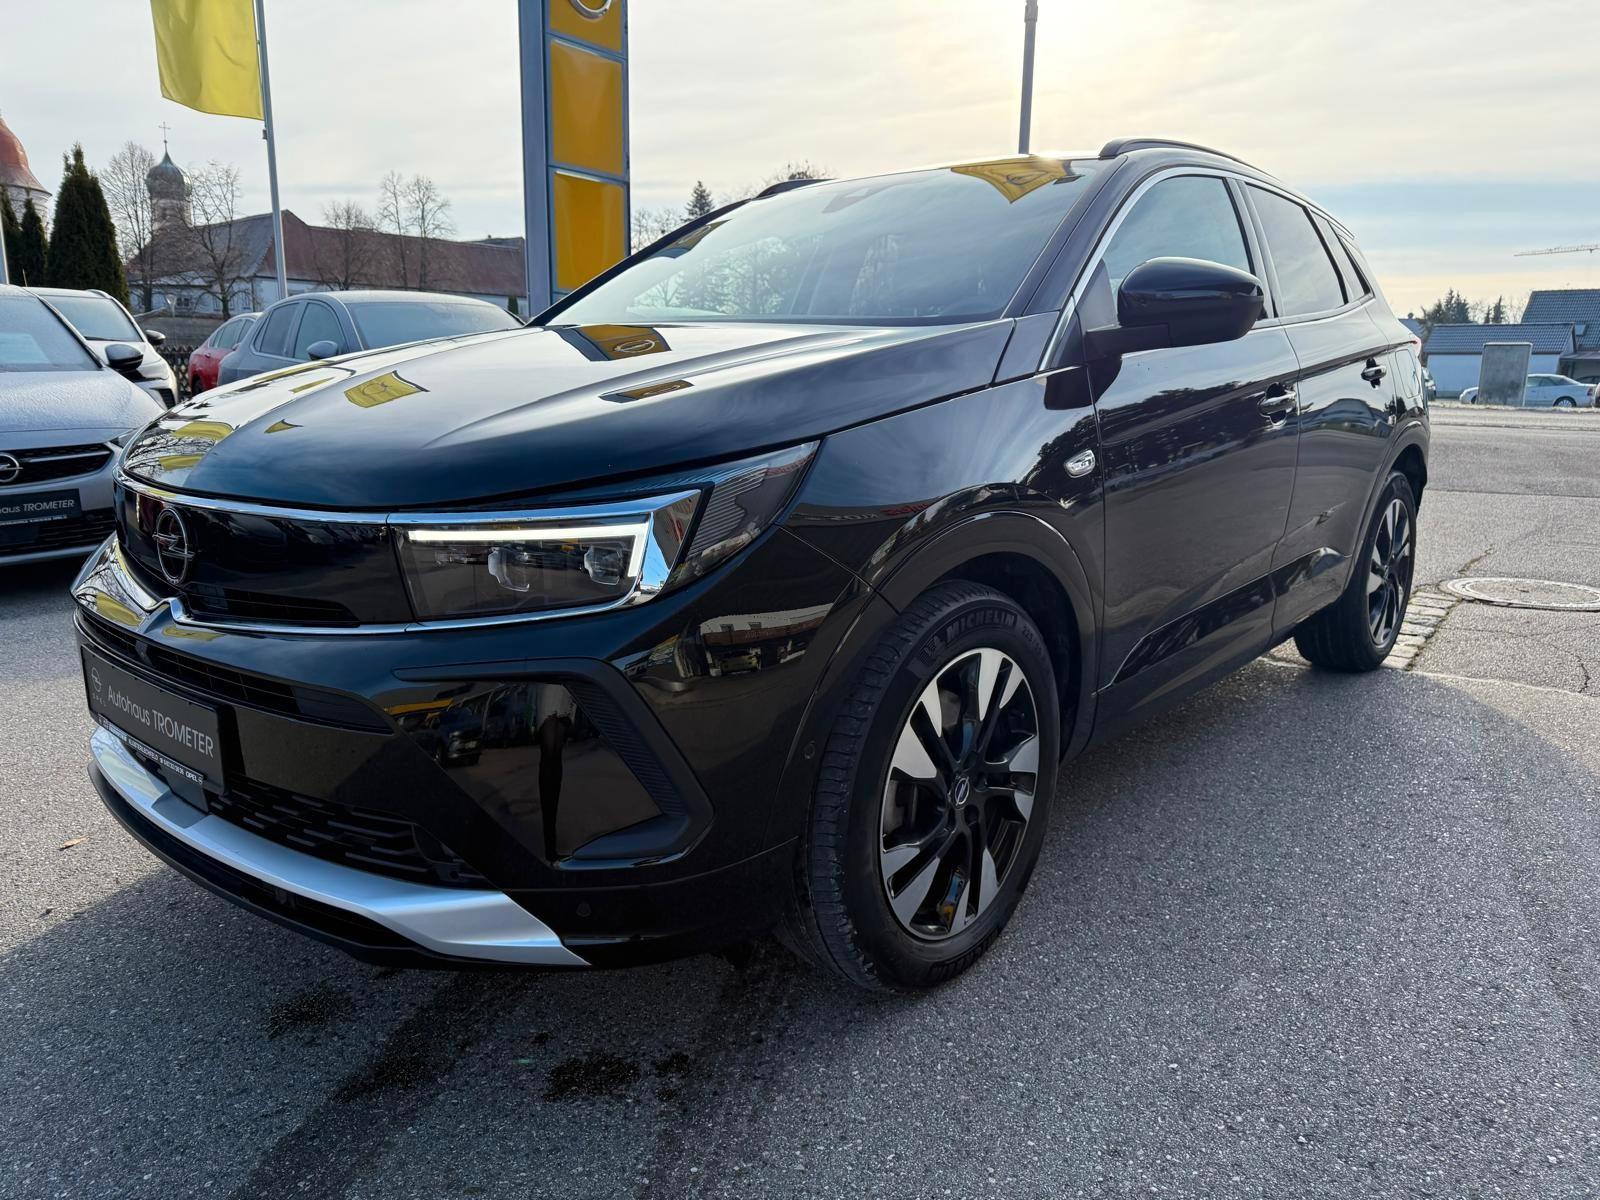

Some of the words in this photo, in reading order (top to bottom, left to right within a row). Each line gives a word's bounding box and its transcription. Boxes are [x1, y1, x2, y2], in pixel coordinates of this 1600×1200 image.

[23, 499, 75, 512] TROMETER
[946, 609, 1016, 643] MICHELIN
[108, 685, 150, 726] Autohaus
[152, 709, 214, 758] TROMETER
